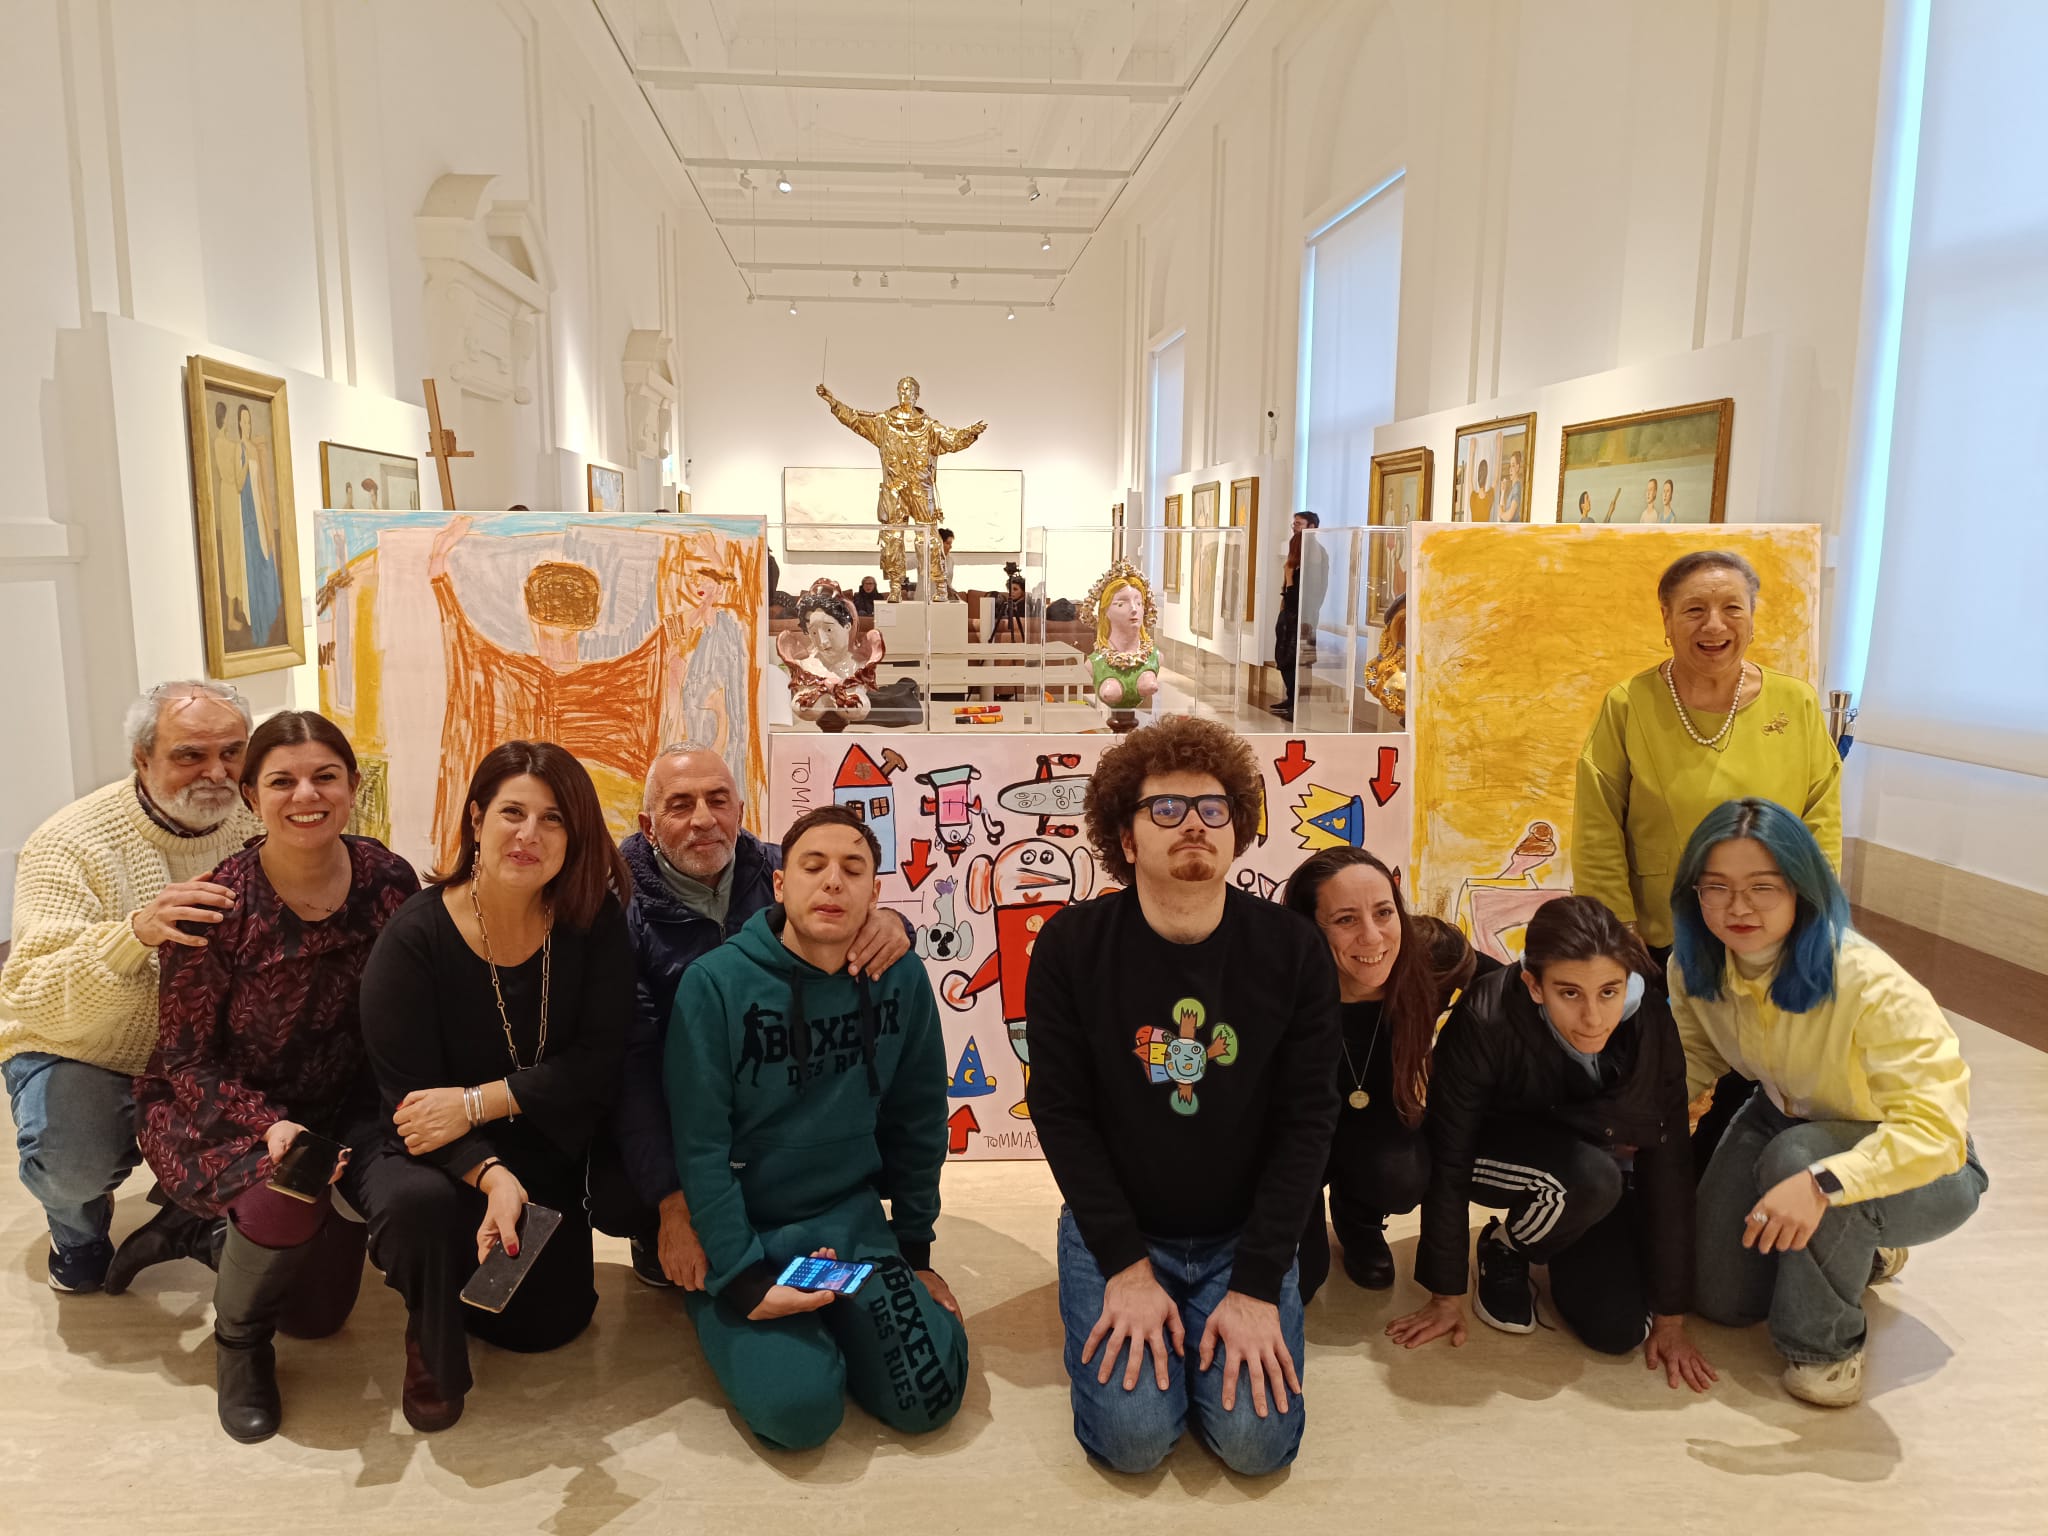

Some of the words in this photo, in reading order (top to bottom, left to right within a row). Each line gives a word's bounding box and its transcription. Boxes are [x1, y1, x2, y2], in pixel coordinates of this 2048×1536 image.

[868, 1295, 896, 1341] DES
[883, 1346, 917, 1411] RUES
[881, 1267, 955, 1421] BOXEUR
